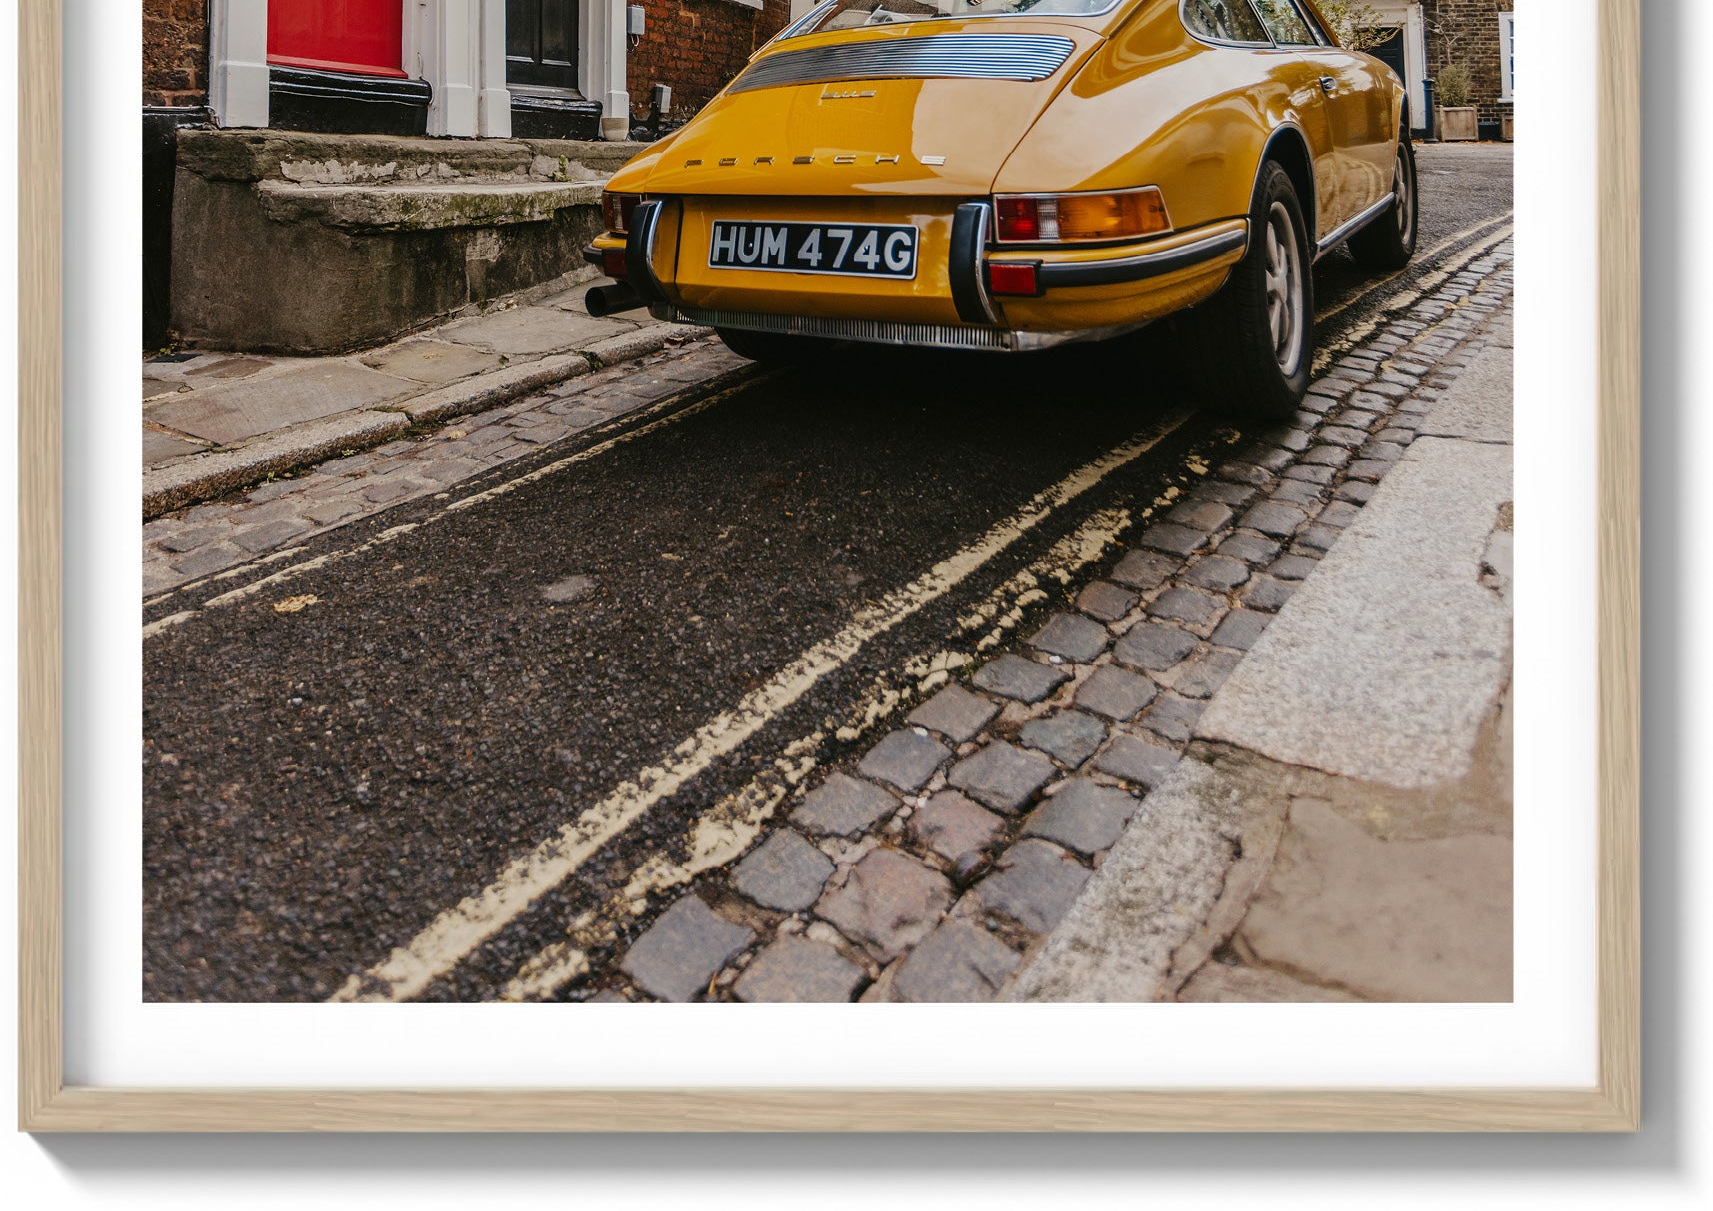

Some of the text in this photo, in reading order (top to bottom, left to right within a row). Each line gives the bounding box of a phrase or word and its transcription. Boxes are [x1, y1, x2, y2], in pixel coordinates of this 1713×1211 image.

[684, 154, 947, 169] PORSCHE
[712, 224, 913, 272] HUM 474G
